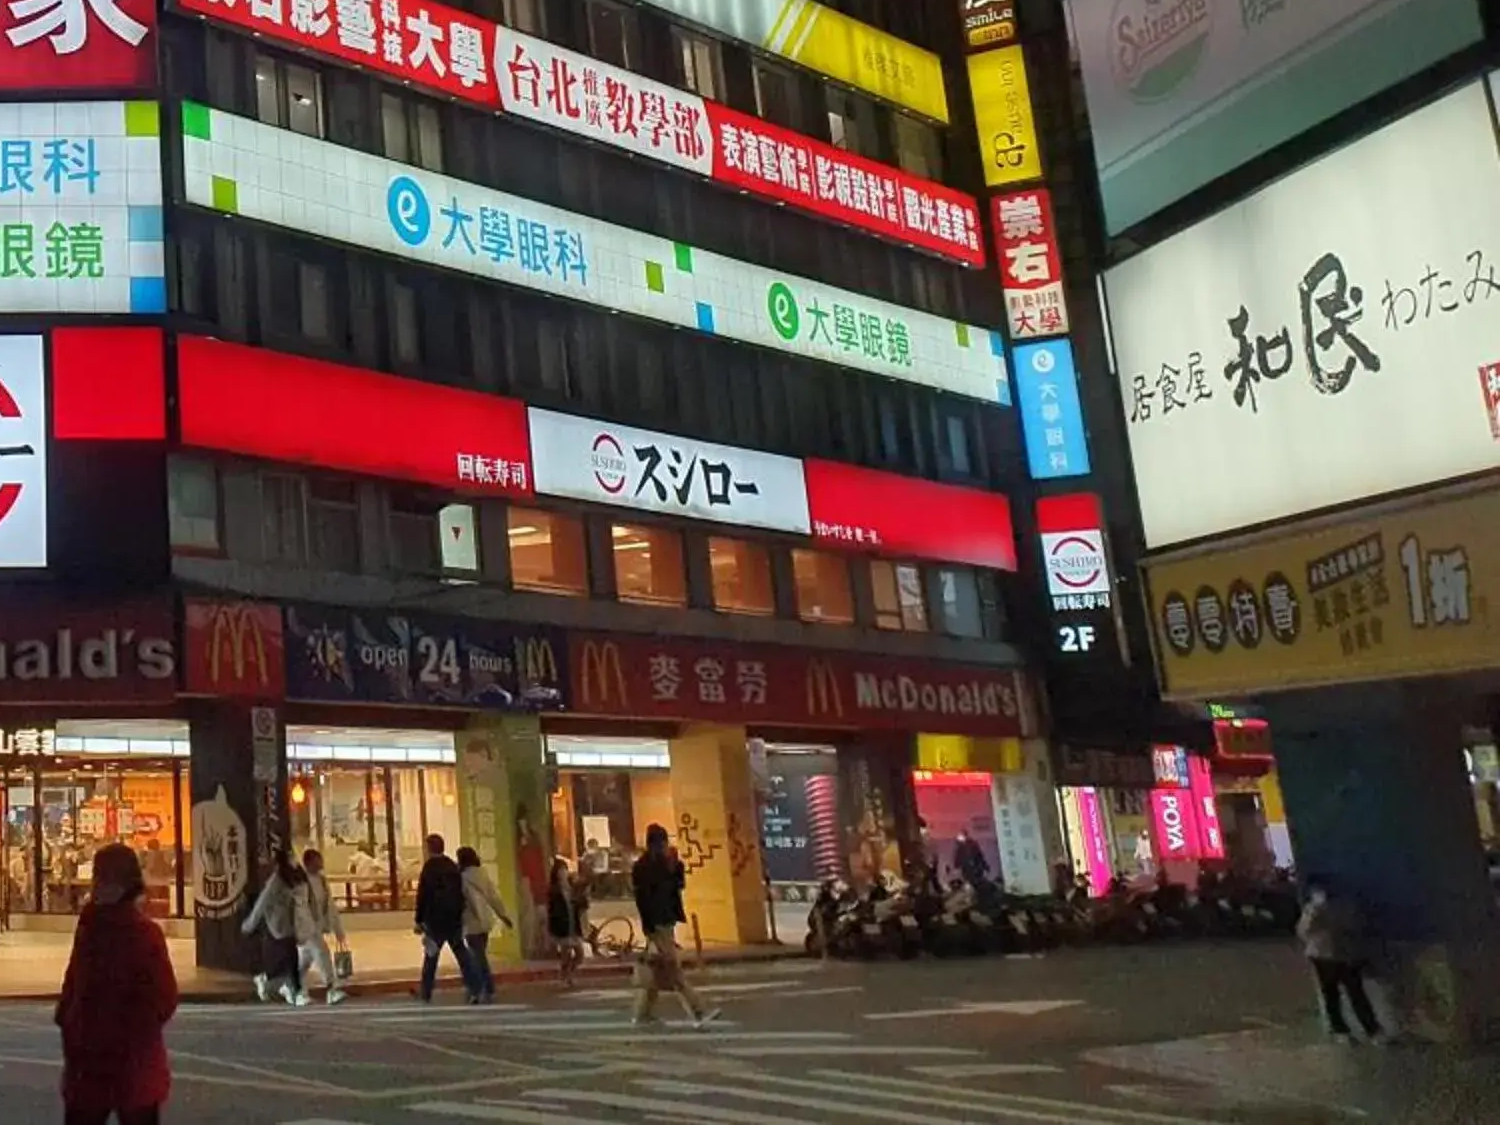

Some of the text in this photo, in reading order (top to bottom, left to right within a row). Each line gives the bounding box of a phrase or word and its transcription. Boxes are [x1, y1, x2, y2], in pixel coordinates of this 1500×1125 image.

[440, 197, 589, 287] 大學眼科
[999, 195, 1049, 284] 崇右
[806, 298, 913, 367] 大學眼鏡
[1013, 307, 1063, 335] 大學
[1130, 351, 1214, 423] 居食屋
[1223, 252, 1381, 414] 和民
[1381, 250, 1500, 331] わたみ
[1038, 379, 1069, 470] 大學眼科
[455, 451, 528, 490] 回転寿司
[633, 444, 760, 507] スシロー
[1052, 591, 1111, 611] 回転寿司
[361, 636, 512, 685] open 24 hours
[1059, 624, 1097, 652] 2F
[649, 653, 768, 706] 麥當勞
[856, 671, 1018, 719] McDonald's
[1161, 795, 1185, 852] POYA
